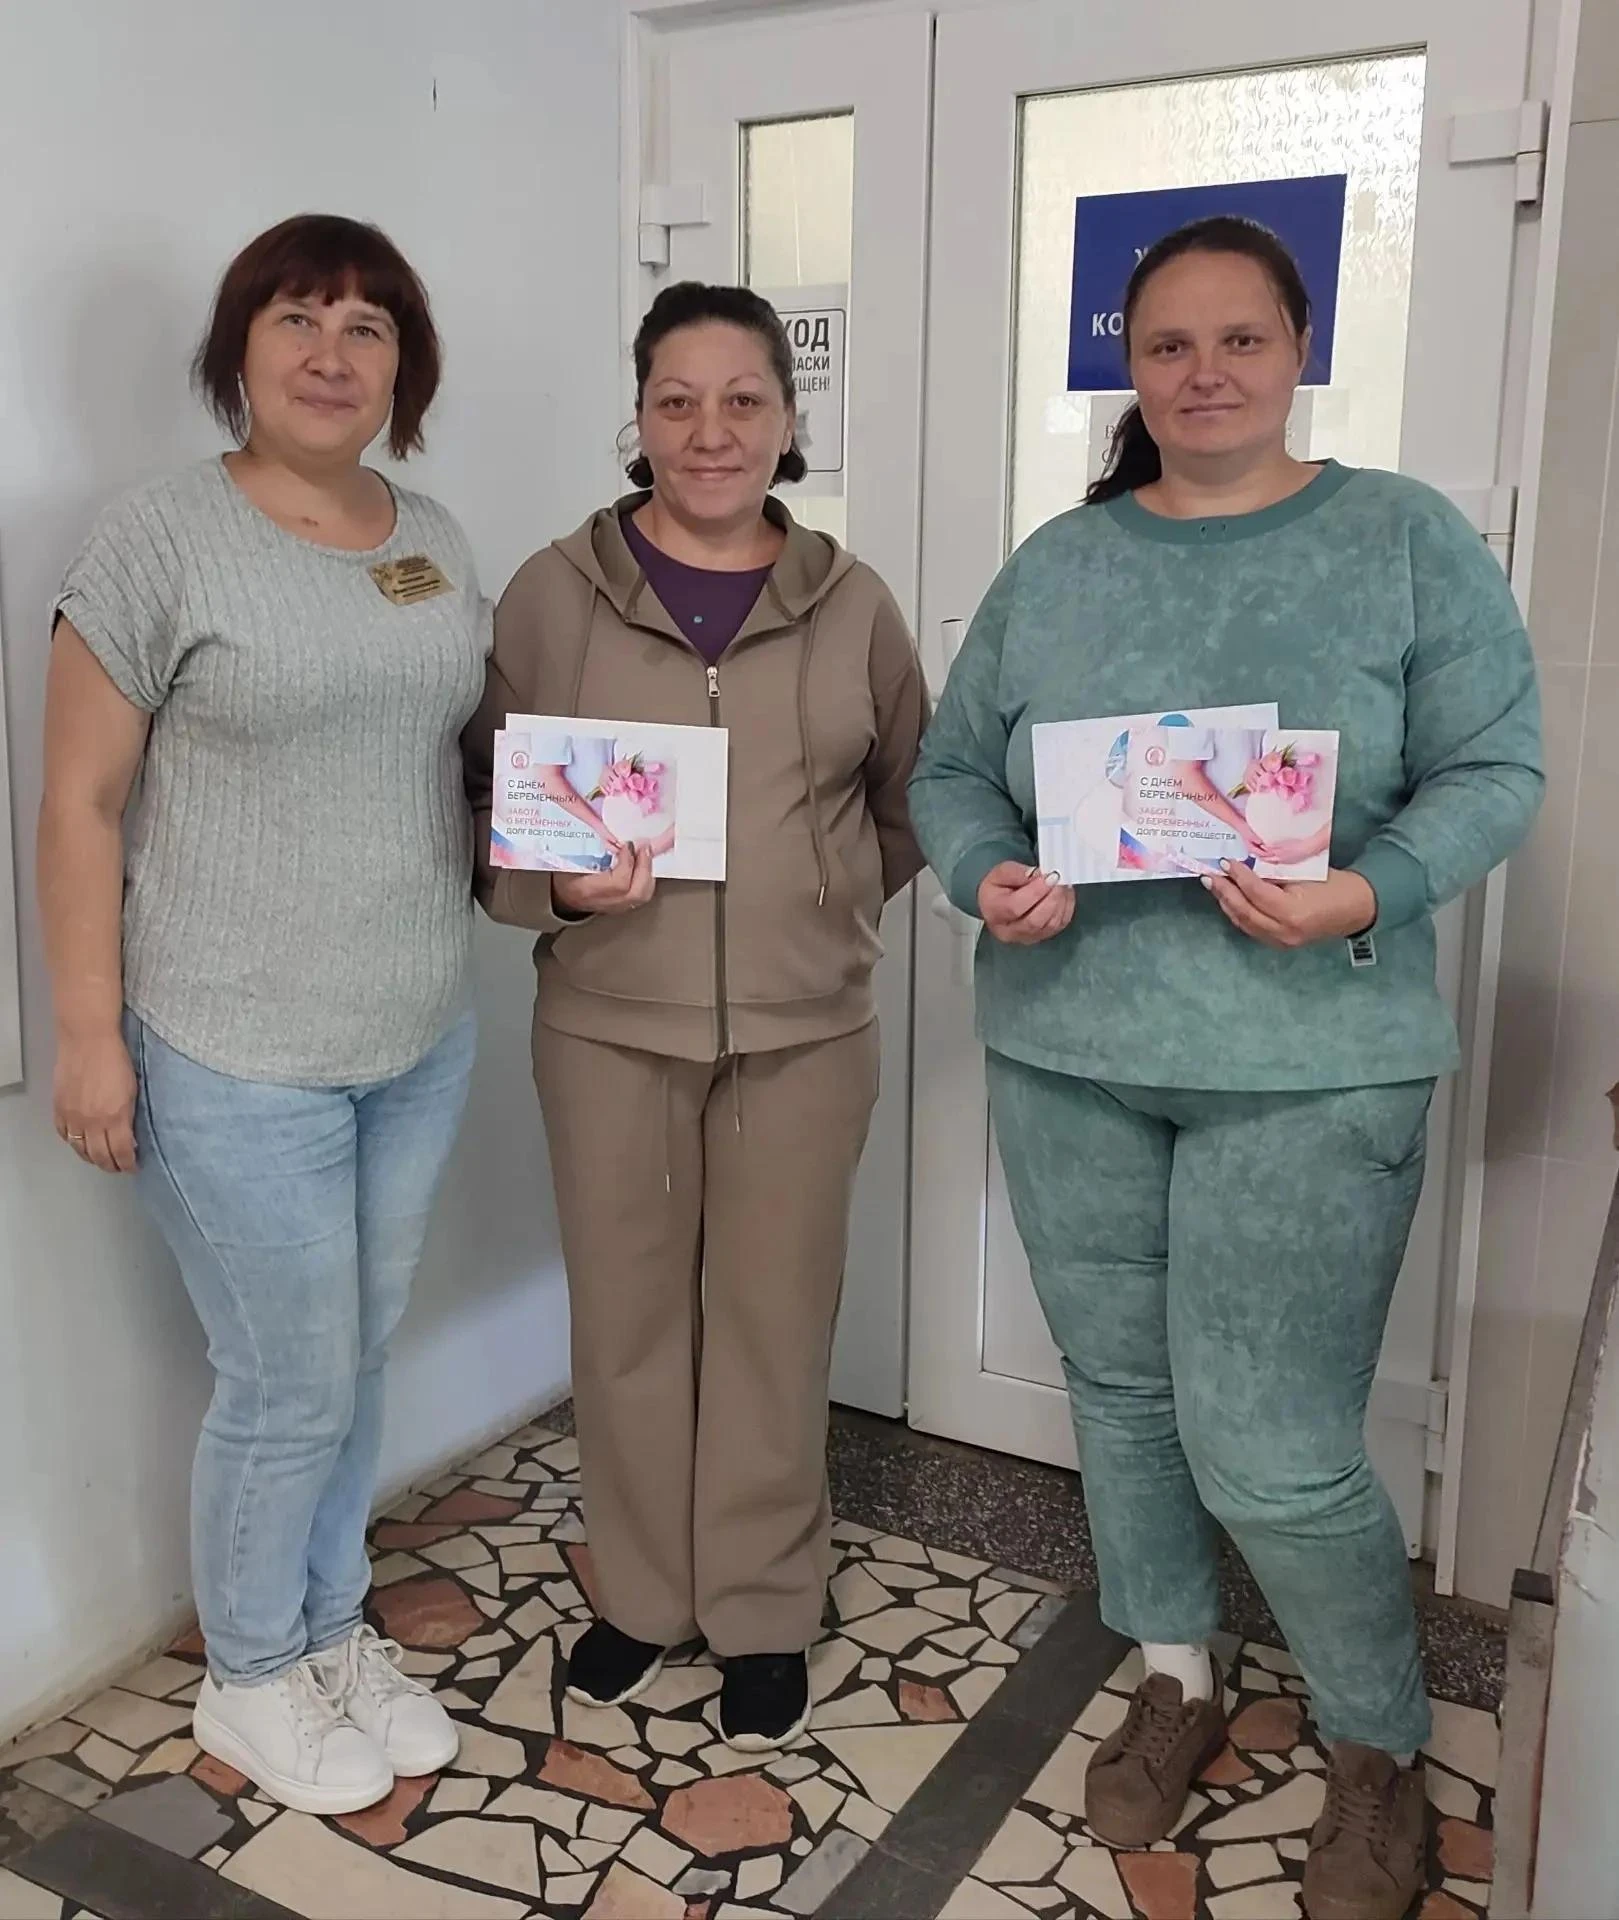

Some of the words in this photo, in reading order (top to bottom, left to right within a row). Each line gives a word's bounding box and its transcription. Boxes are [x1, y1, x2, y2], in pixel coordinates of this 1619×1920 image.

[507, 779, 515, 788] С
[1140, 776, 1149, 786] С
[507, 791, 577, 803] БЕРЕМЕННЫХ!
[1139, 789, 1218, 802] БЕРЕМЕННЫХ!
[1137, 807, 1176, 816] ЗАБОТА
[506, 816, 513, 824] О
[1137, 817, 1145, 825] О
[1146, 817, 1210, 828] БЕРЕМЕННЫХ
[506, 827, 527, 836] ДОЛГ
[528, 828, 553, 837] ВСЕГО
[553, 830, 596, 839] ОБЩЕСТВА
[1136, 827, 1160, 836] ДОЛГ
[1161, 829, 1188, 838] ВСЕГО
[1189, 831, 1237, 840] ОБЩЕСТВА
